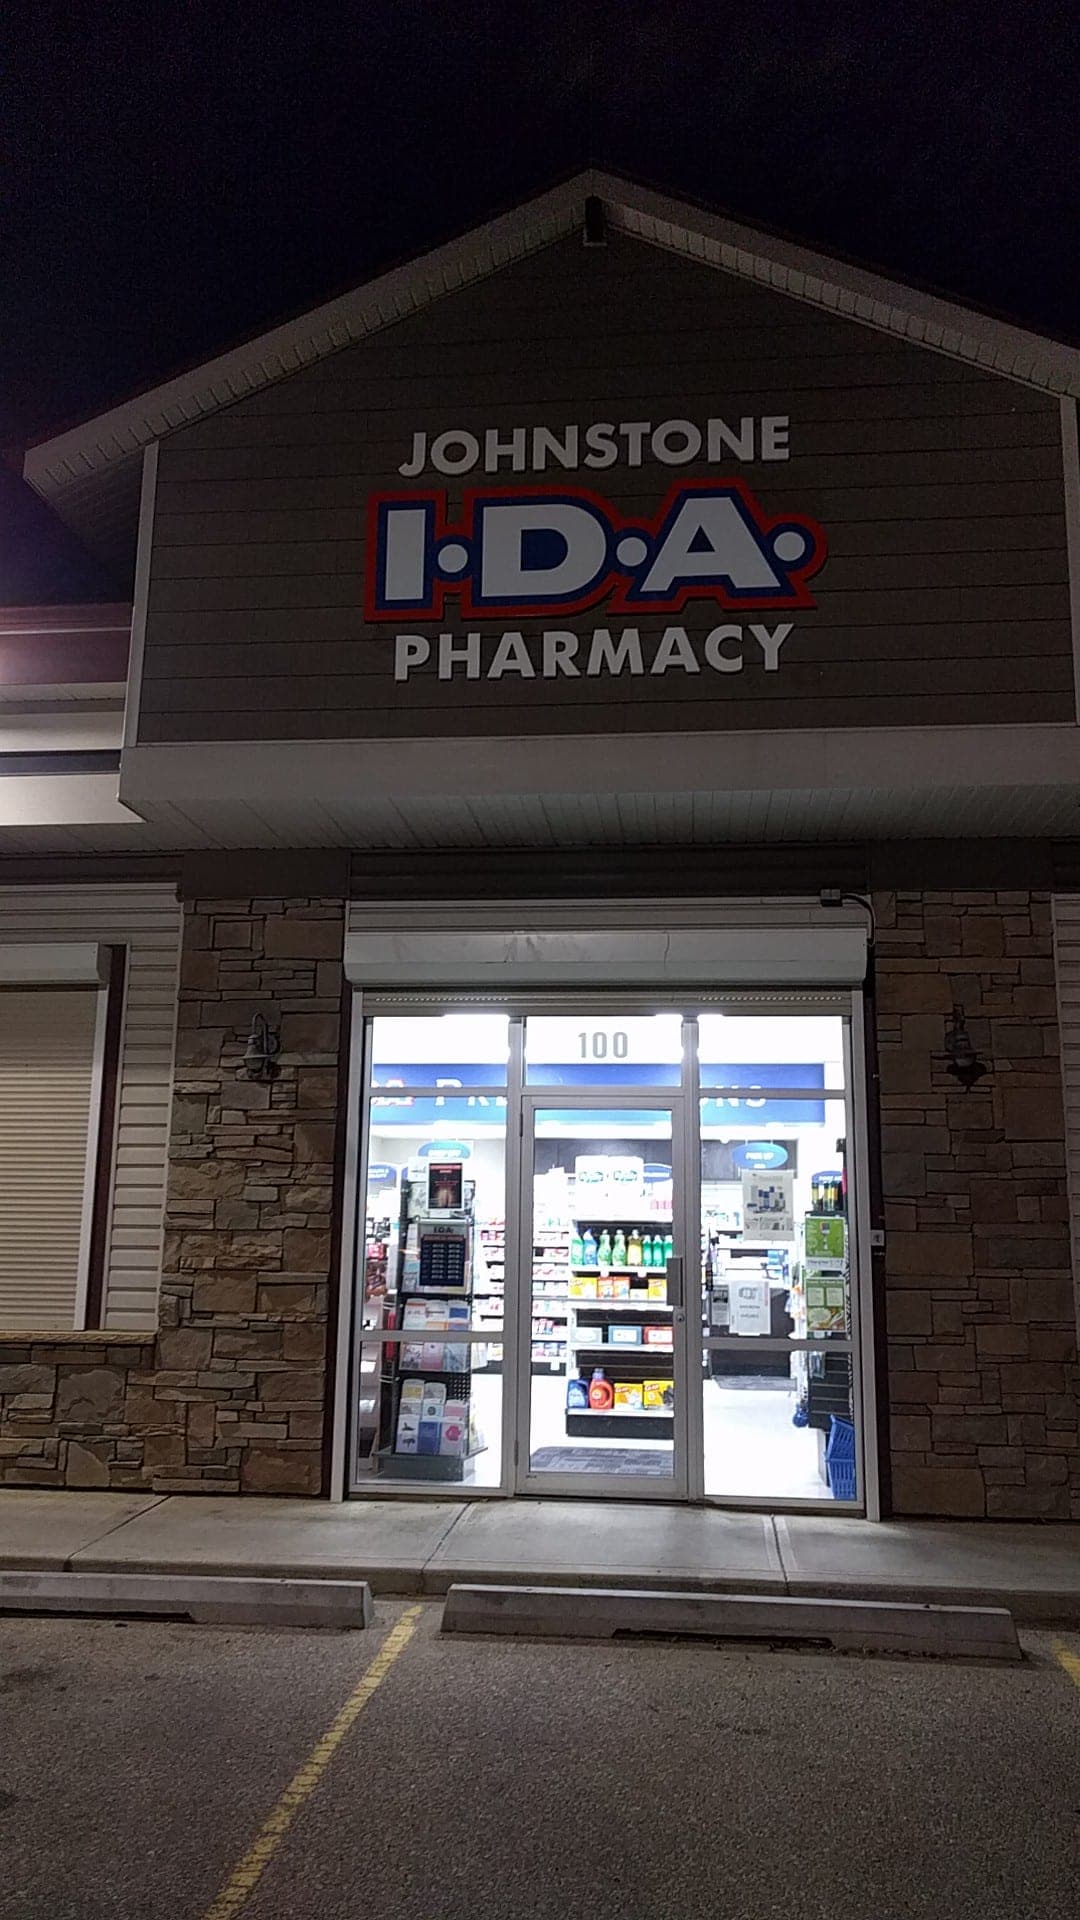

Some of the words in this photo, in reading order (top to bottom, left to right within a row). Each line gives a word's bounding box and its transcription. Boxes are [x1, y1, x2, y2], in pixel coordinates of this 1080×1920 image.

[398, 416, 790, 477] JOHNSTONE
[394, 623, 795, 681] PHARMACY
[578, 1031, 628, 1059] 100
